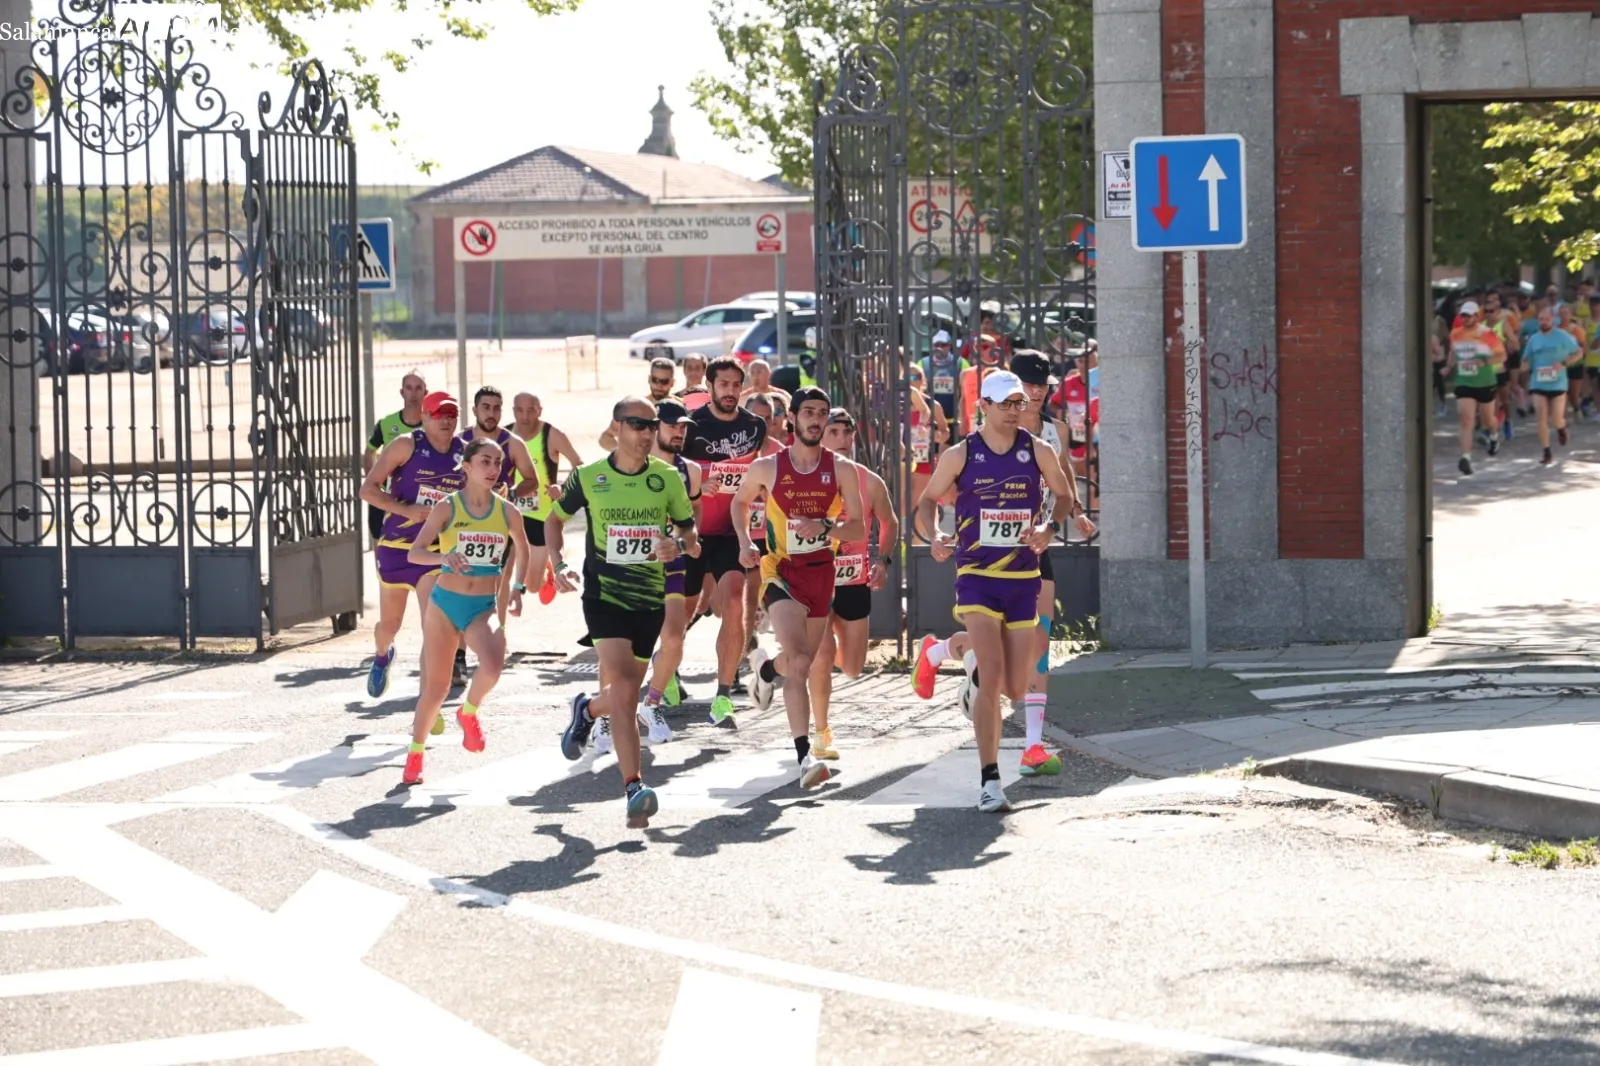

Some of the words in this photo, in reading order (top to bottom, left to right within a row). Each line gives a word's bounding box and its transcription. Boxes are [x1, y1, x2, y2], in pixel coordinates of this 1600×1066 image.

[498, 220, 539, 230] ACCESO
[542, 219, 596, 229] PROHIBIDO
[598, 219, 606, 228] A
[608, 218, 635, 228] TODA
[637, 217, 686, 228] PERSONA
[687, 217, 693, 227] Y
[541, 232, 588, 243] EXCEPTO
[590, 231, 643, 242] PERSONAL
[646, 230, 665, 241] DEL
[668, 230, 709, 240] CENTRO
[589, 245, 600, 255] SE
[604, 244, 632, 254] AVISA
[600, 507, 662, 521] CORRECAMINOS
[982, 511, 1030, 520] bedunia
[988, 521, 1023, 538] 787
[459, 532, 504, 544] bedunia
[464, 542, 496, 558] 831
[616, 538, 652, 555] 878
